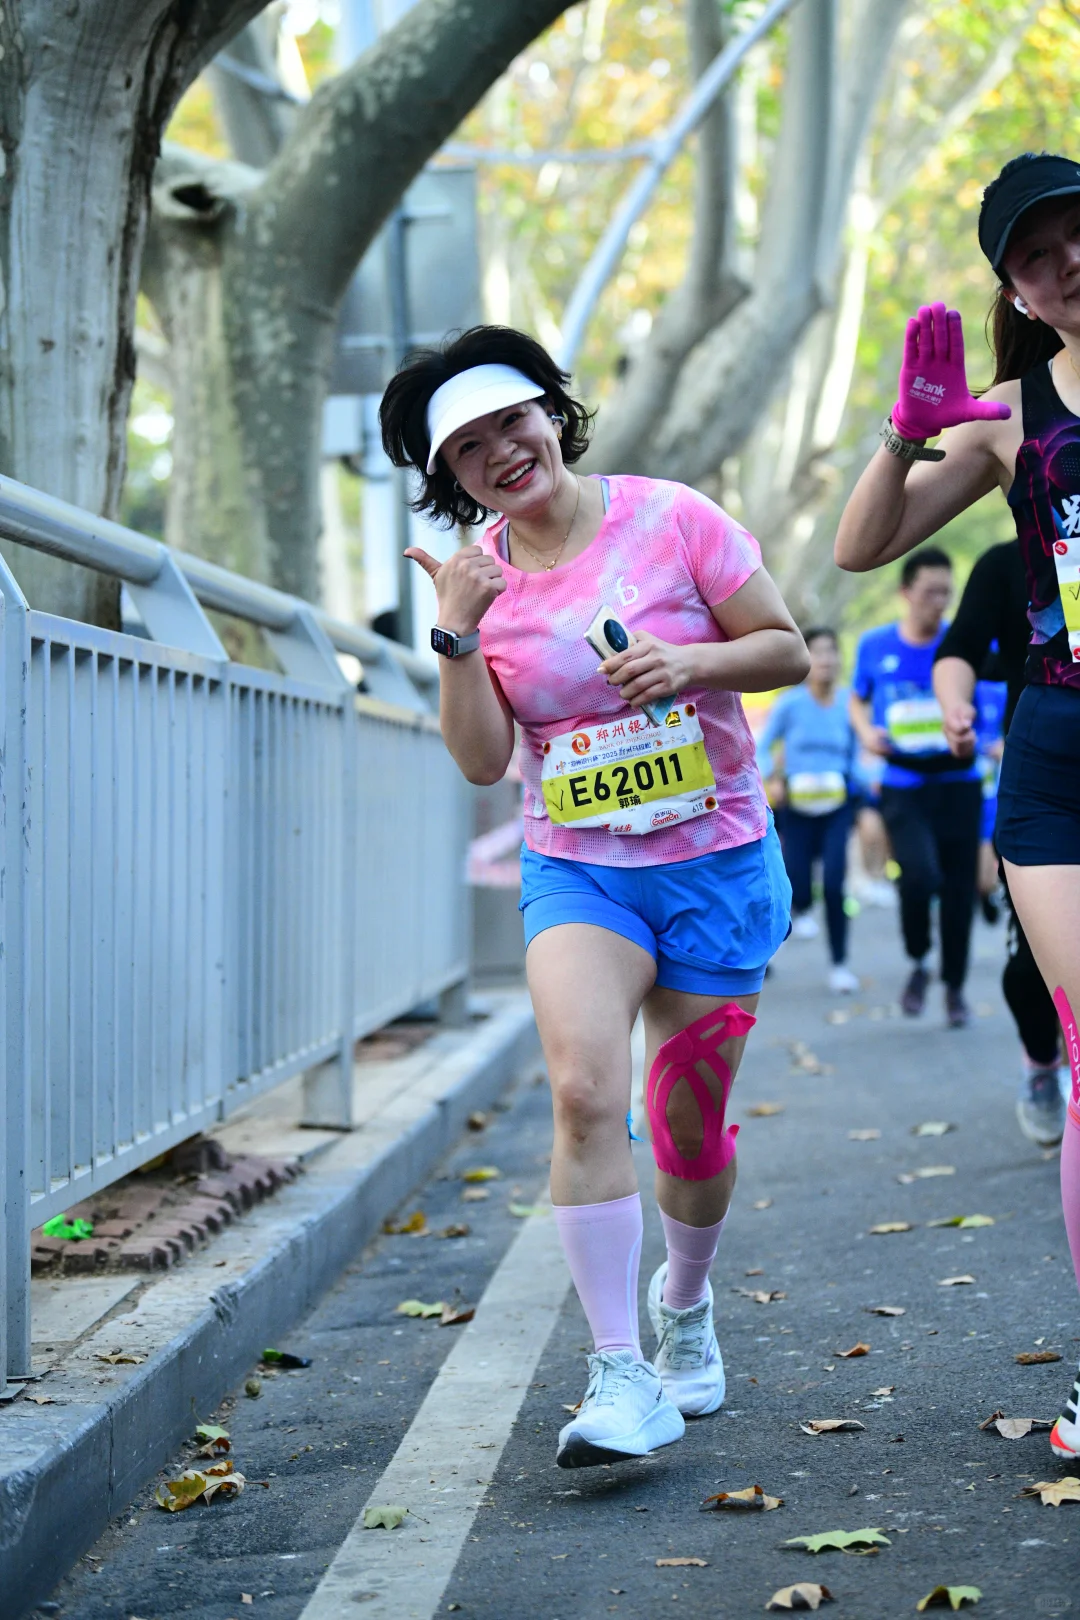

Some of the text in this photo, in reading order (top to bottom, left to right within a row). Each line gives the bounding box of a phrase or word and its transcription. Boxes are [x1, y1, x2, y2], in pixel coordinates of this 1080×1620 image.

[569, 752, 683, 807] E62011
[617, 794, 642, 809] 郭瑜
[692, 802, 704, 813] 618
